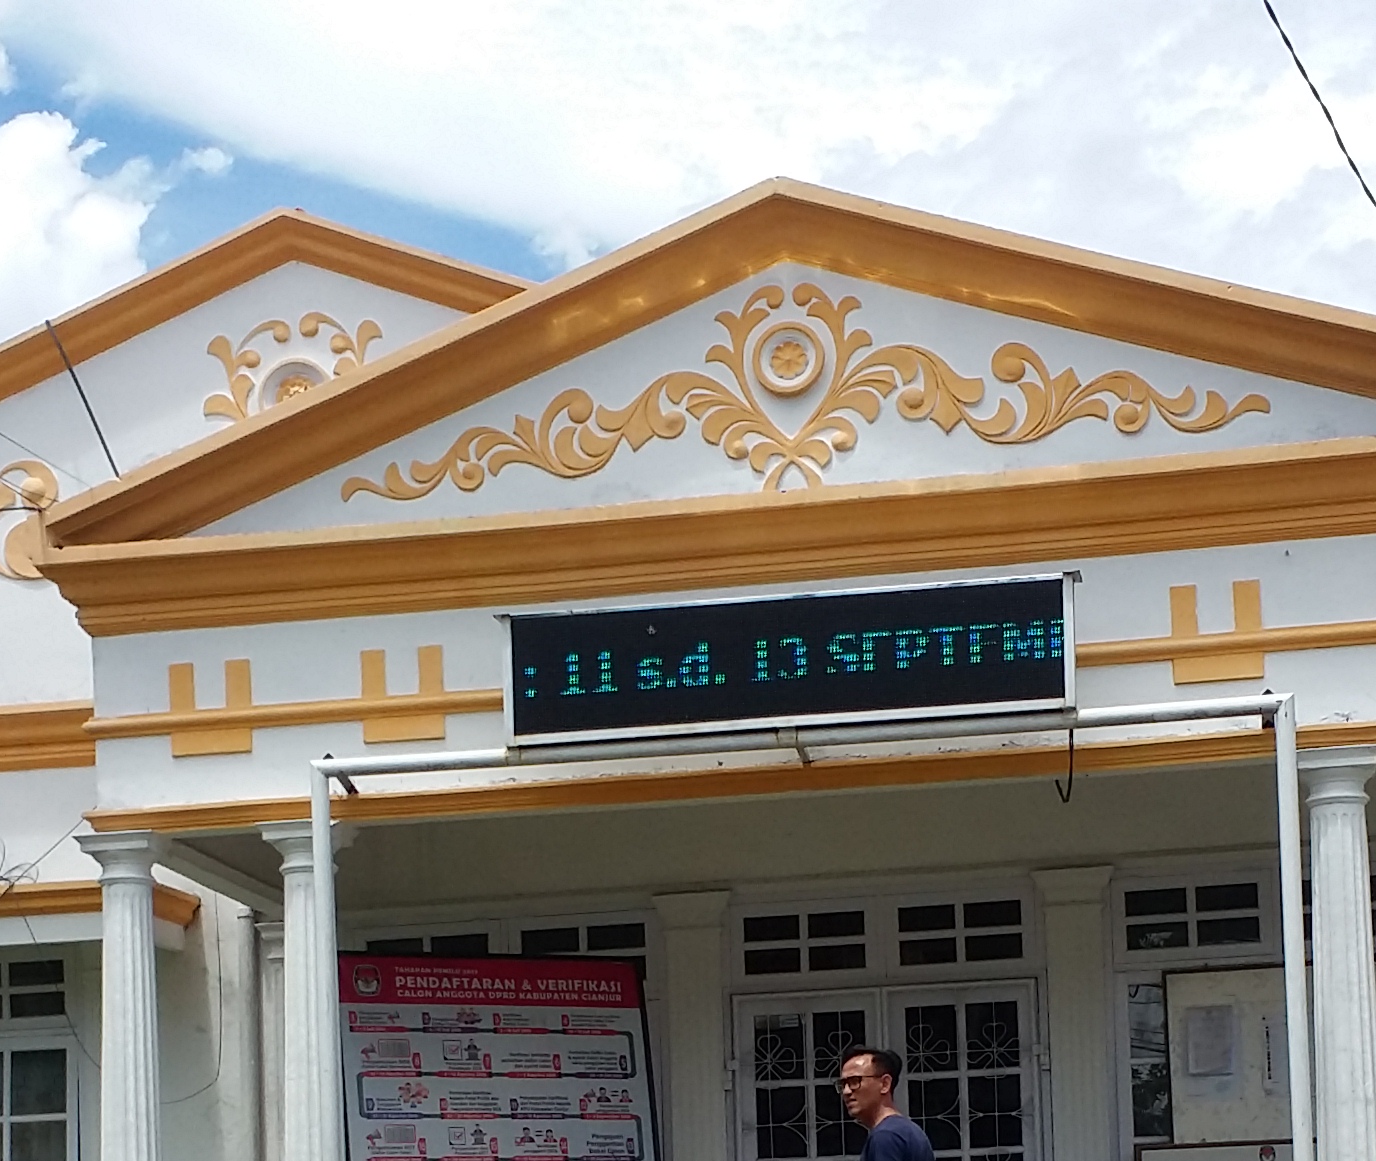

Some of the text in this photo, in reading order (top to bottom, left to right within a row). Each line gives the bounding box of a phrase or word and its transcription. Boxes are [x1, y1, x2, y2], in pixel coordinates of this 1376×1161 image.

[395, 976, 623, 993] PENDAFTARAN & VERIFIKASI
[396, 989, 432, 998] CALON
[435, 990, 486, 999] ANGGOTA
[519, 992, 578, 1001] KABUPATEN
[581, 993, 623, 1002] CIANJUR
